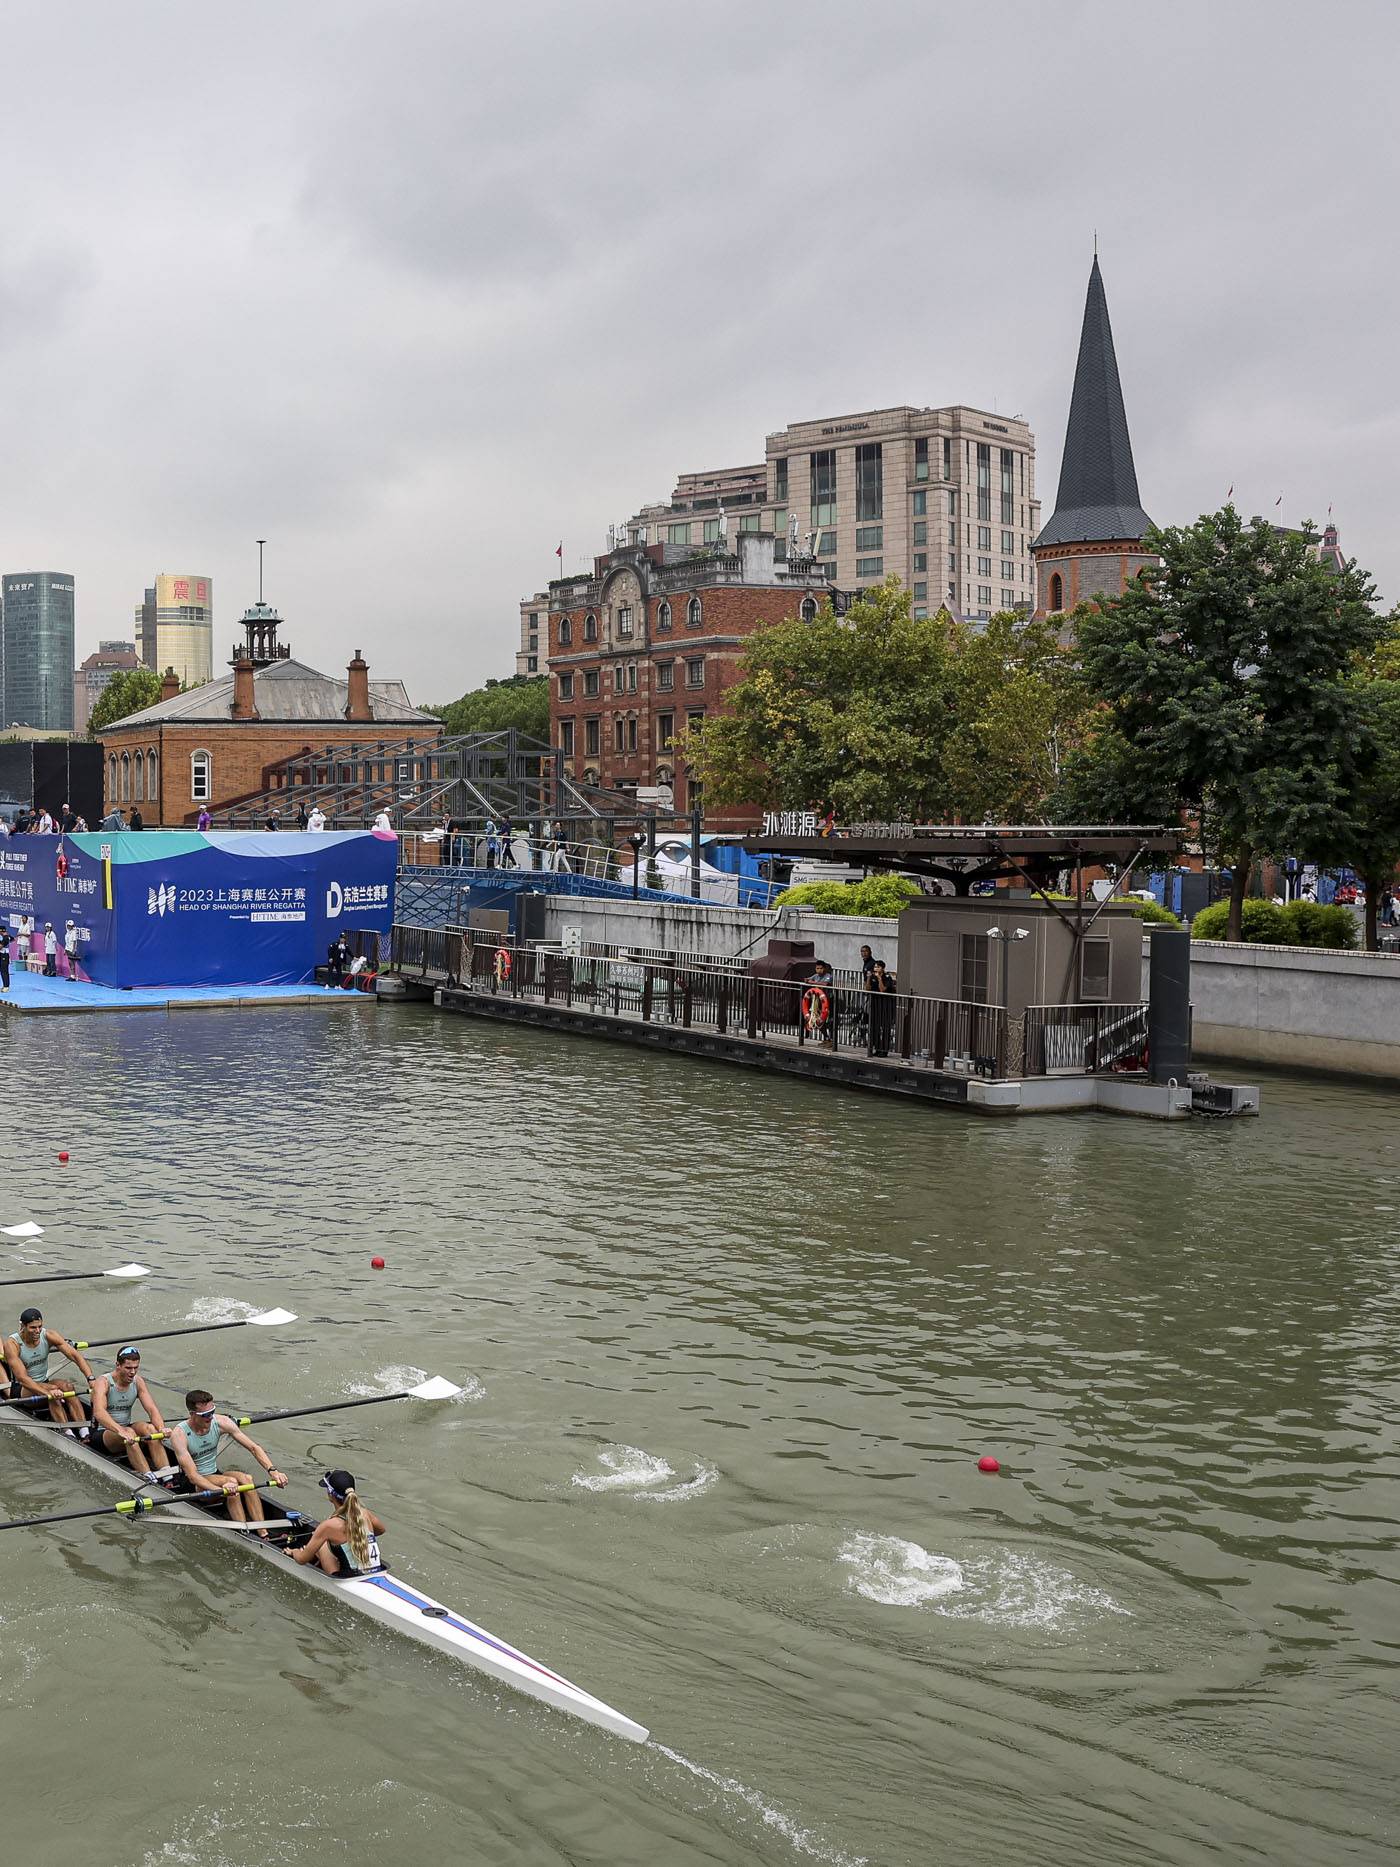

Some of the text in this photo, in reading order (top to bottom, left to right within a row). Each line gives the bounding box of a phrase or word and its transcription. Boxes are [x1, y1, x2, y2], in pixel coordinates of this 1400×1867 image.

[173, 580, 208, 600] 震旦
[762, 811, 816, 837] 外滩源
[793, 876, 808, 884] SMG
[179, 887, 306, 902] 2023上海赛艇公开赛
[343, 884, 389, 903] 东浩兰生赛事
[212, 903, 249, 911] SHANGHAI
[273, 902, 306, 910] REGATTA
